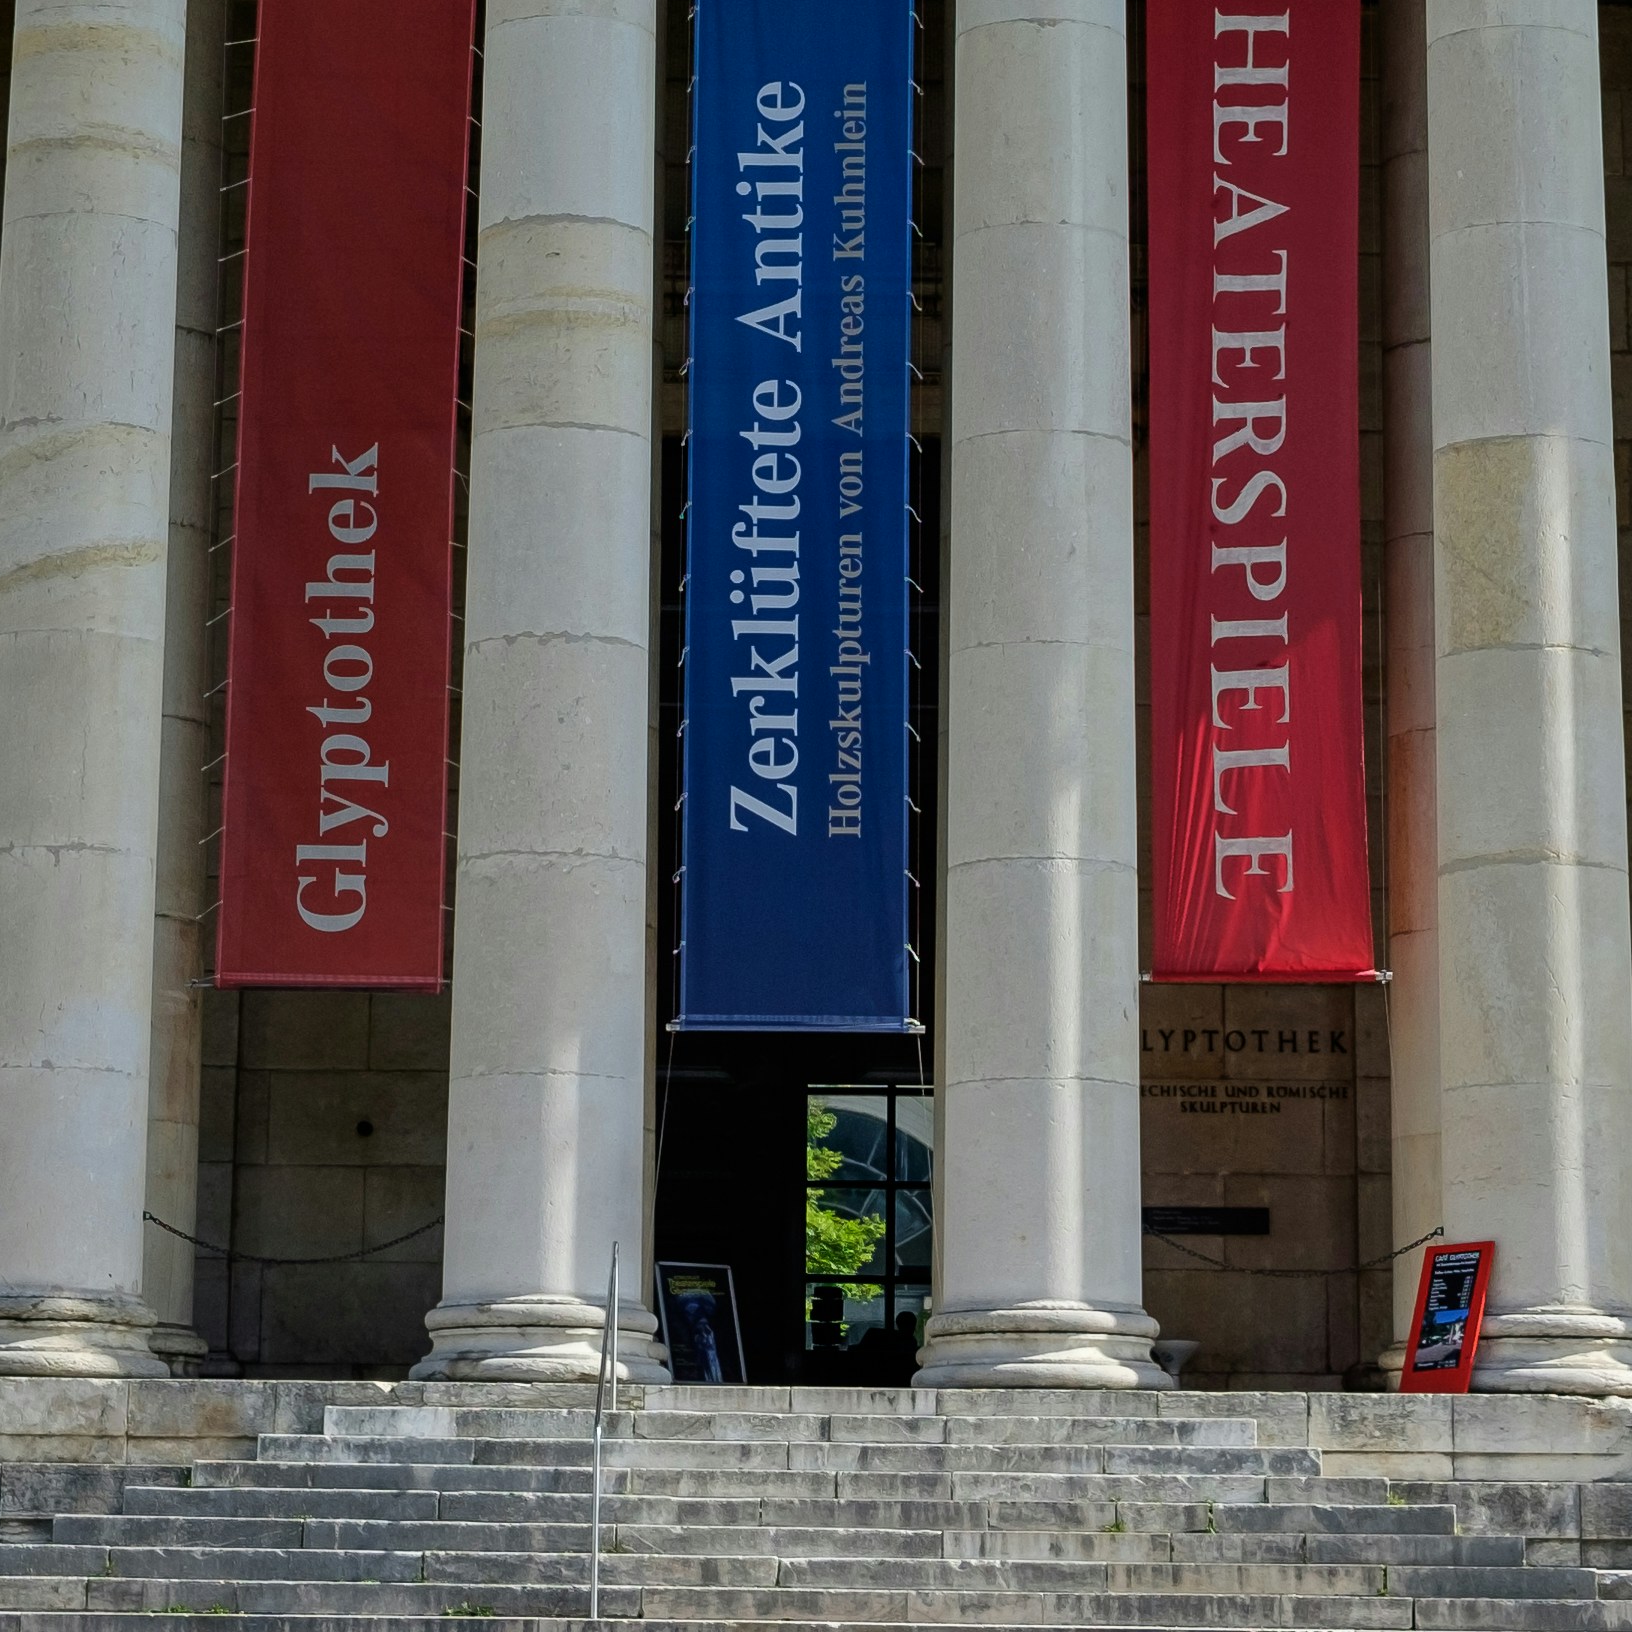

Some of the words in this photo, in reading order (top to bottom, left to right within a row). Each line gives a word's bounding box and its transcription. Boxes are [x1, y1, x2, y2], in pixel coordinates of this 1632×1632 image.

[736, 81, 806, 353] Antike
[833, 82, 866, 261] Kuhnlein
[831, 275, 864, 439] Andreas
[839, 449, 864, 519] von
[296, 442, 389, 932] Glyptothek
[729, 379, 802, 836] Zerklüftete
[828, 531, 871, 838] Holzskulpturen
[1140, 1085, 1217, 1098] ECHISCHE
[1225, 1086, 1259, 1098] UND
[1141, 1029, 1348, 1054] LYPTOTHEK
[1180, 1101, 1281, 1114] SKULPTUREN
